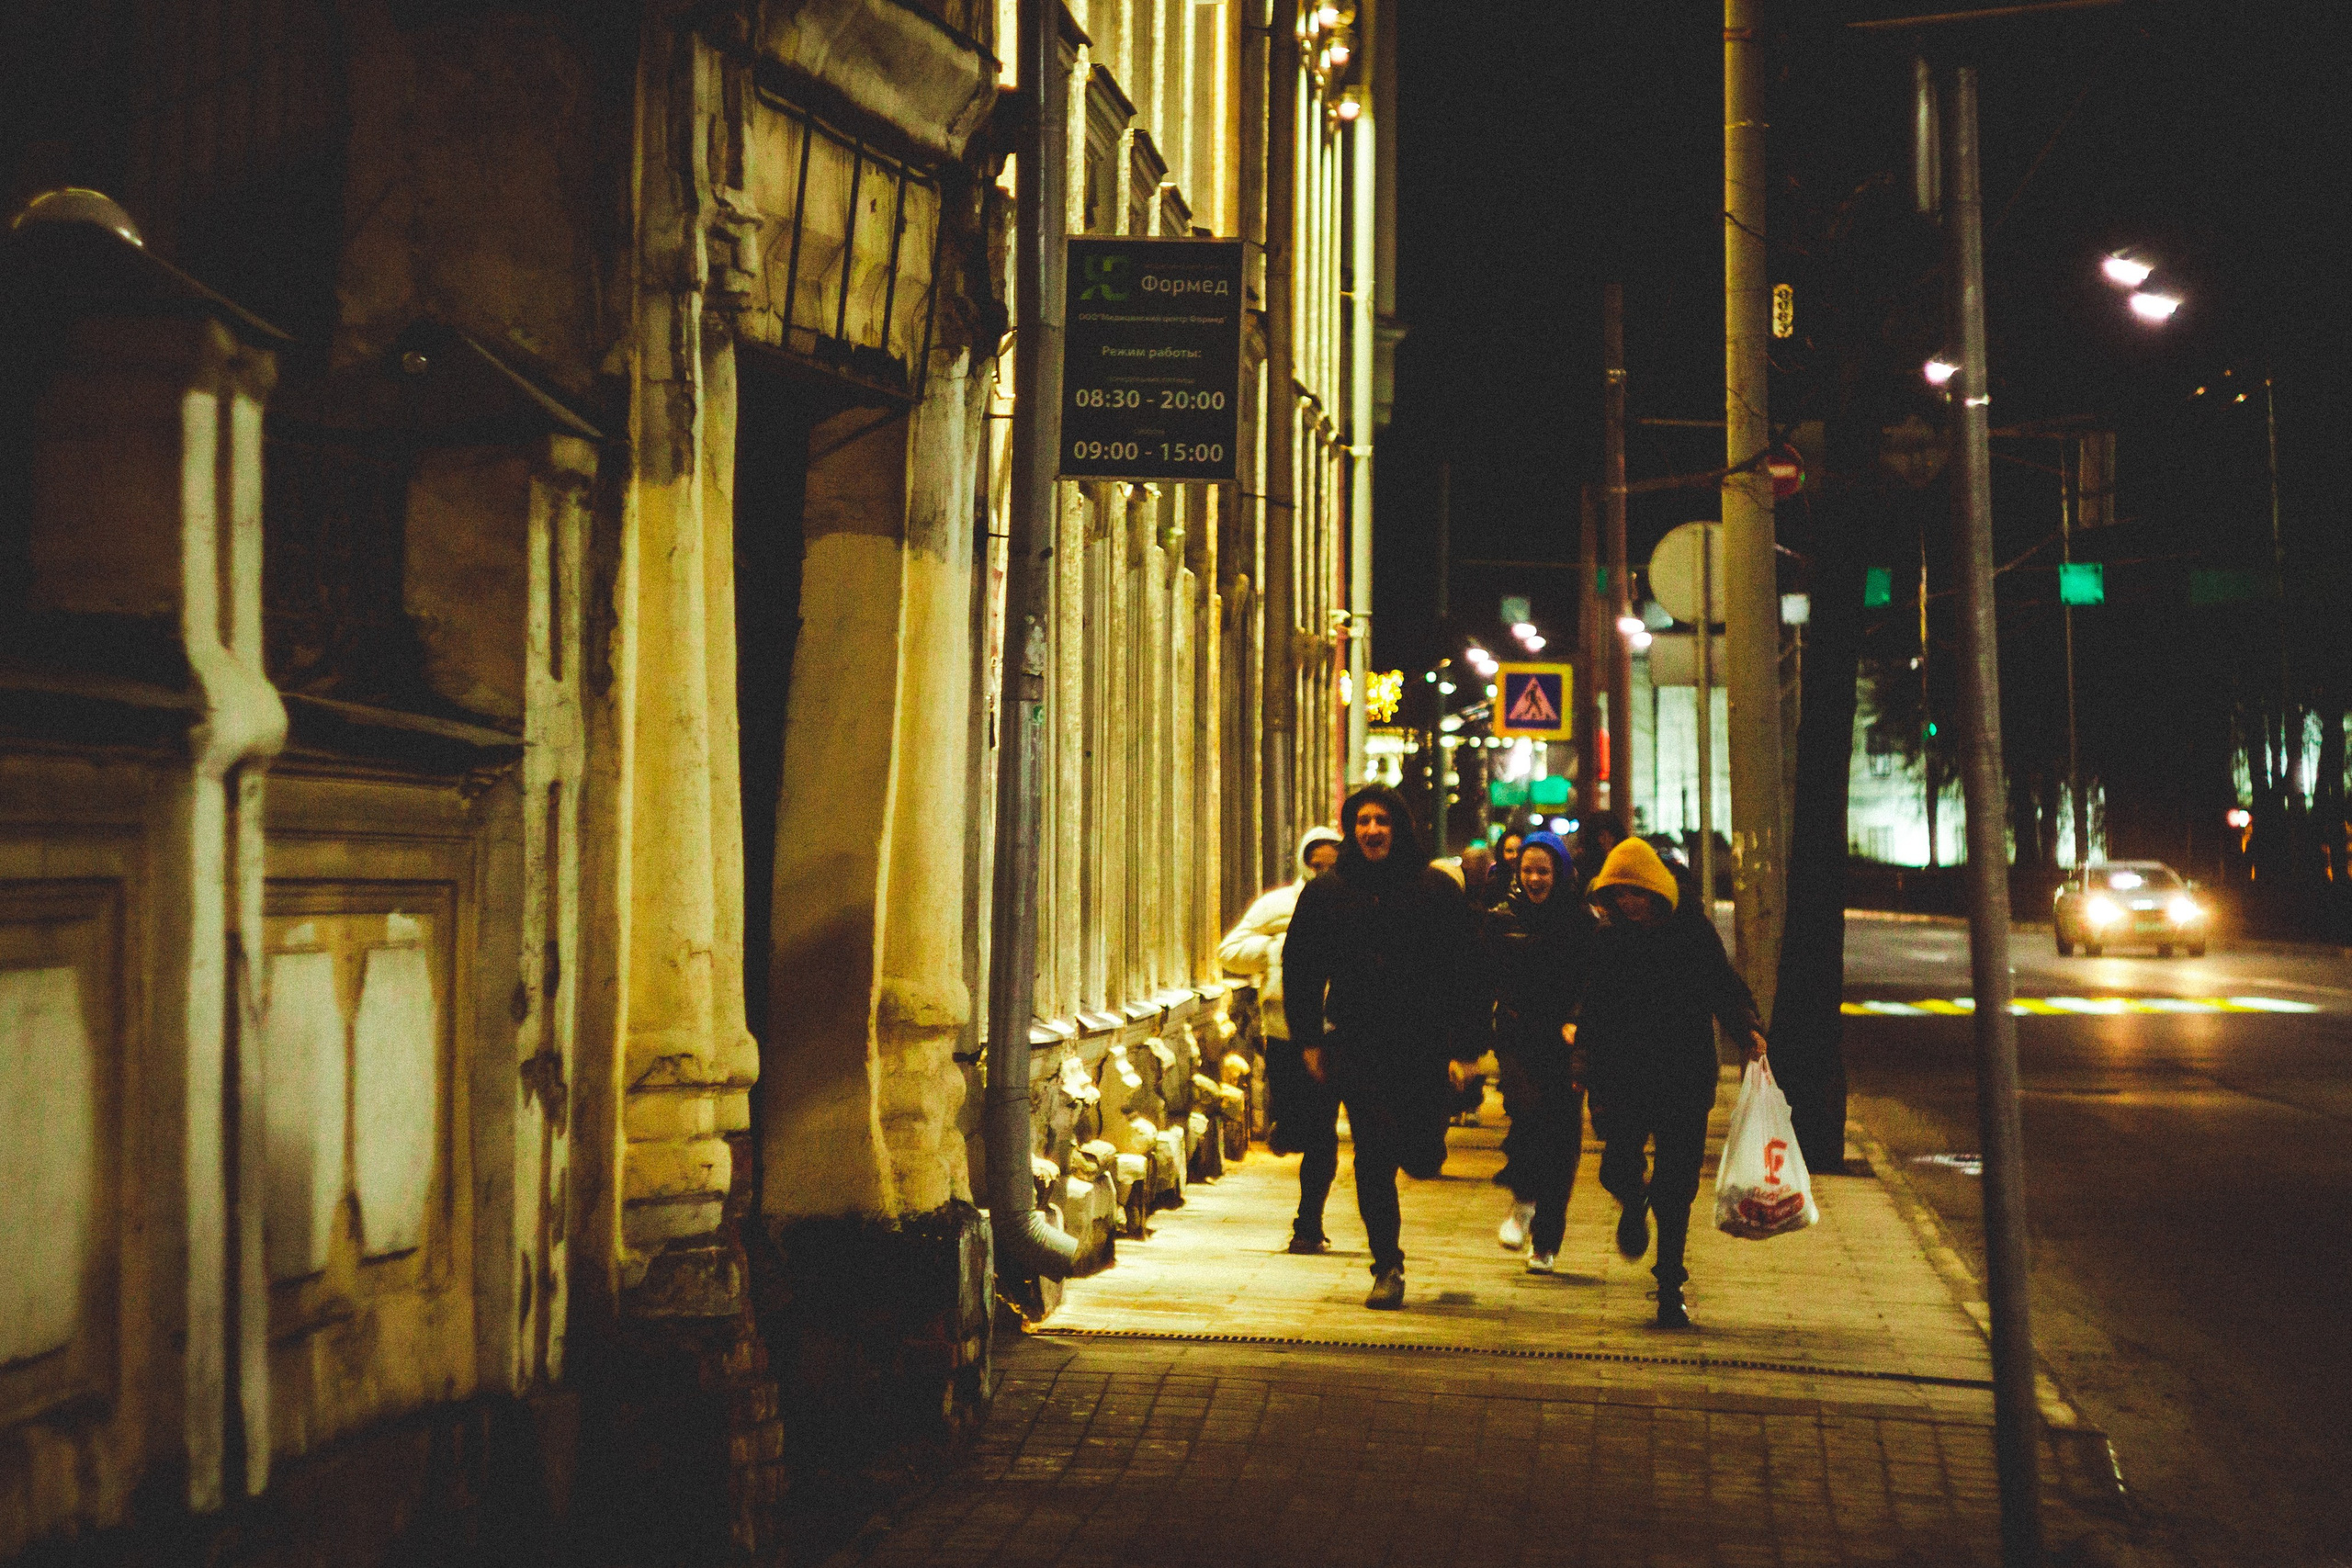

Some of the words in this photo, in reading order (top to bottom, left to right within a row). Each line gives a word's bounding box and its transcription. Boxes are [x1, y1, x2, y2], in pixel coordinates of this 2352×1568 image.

[1141, 275, 1229, 297] Формед
[1102, 345, 1146, 357] Режим
[1148, 346, 1202, 359] работы:
[1076, 389, 1140, 408] 08:30
[1160, 390, 1226, 410] 20:00
[1074, 441, 1138, 460] 09:00
[1159, 443, 1223, 462] 15:00
